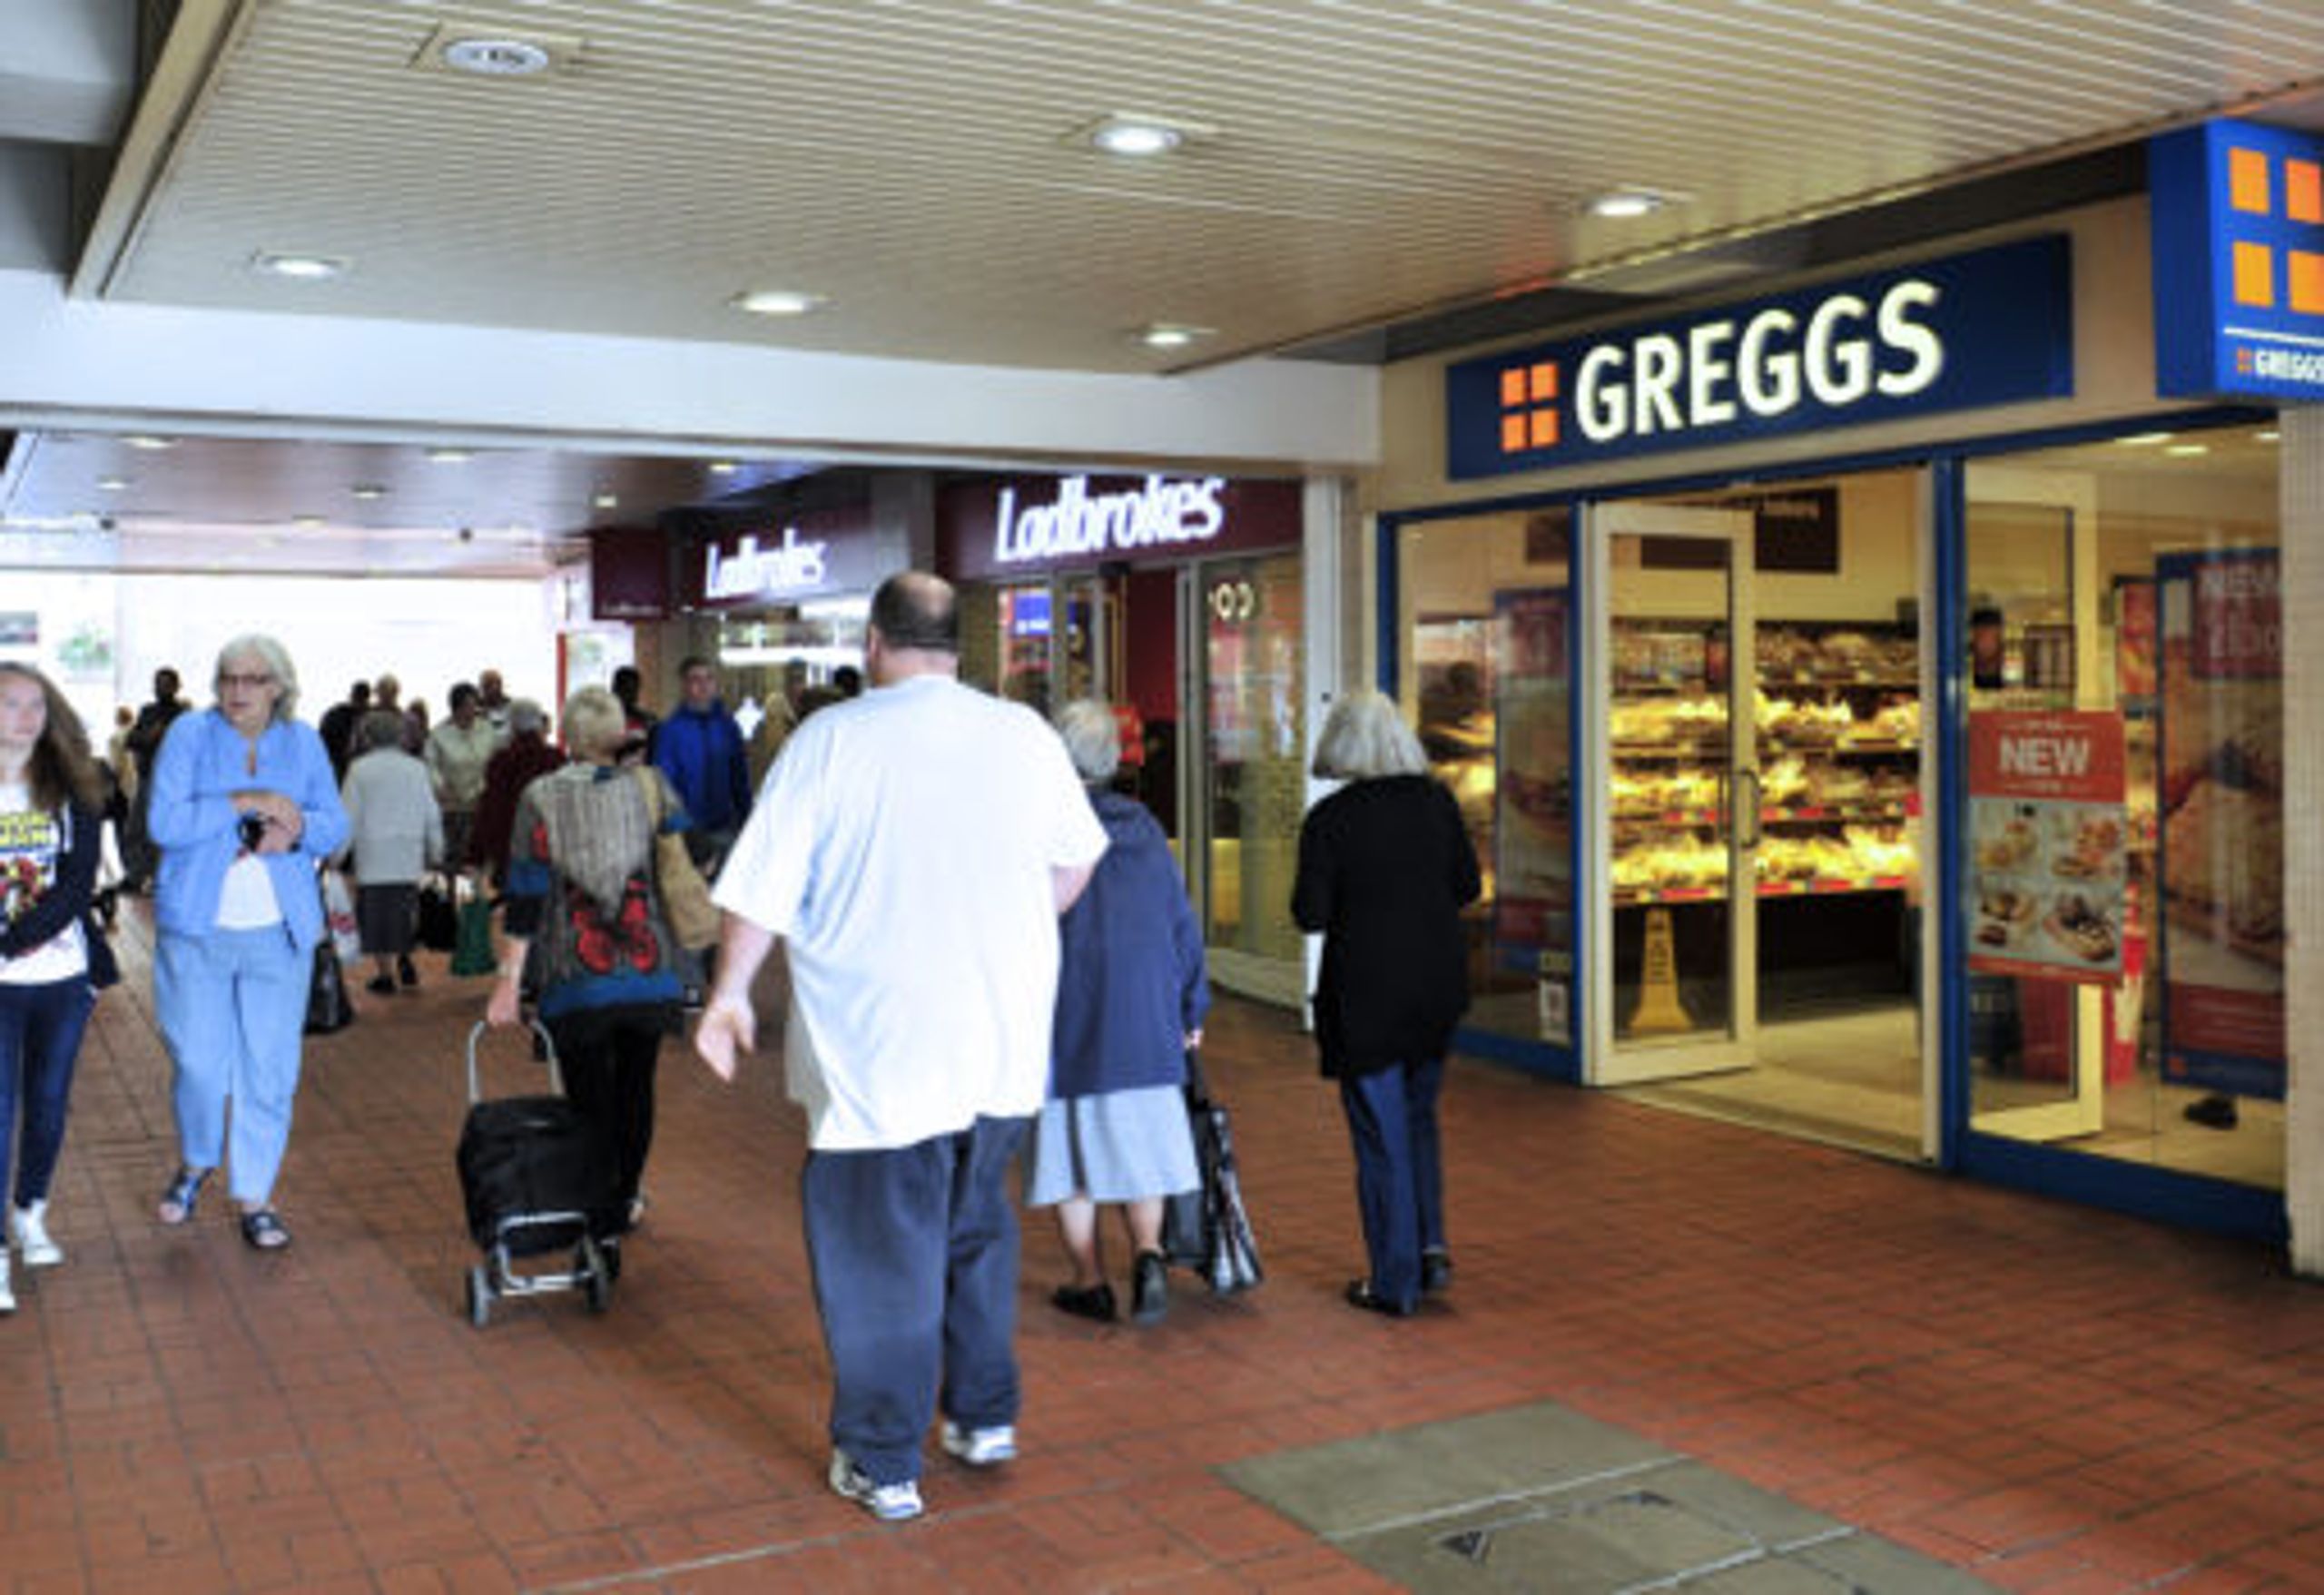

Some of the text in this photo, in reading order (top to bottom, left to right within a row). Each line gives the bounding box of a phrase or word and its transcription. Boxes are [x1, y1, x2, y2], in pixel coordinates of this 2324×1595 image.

[1575, 280, 1943, 442] GREGGS
[995, 473, 1225, 562] Ladbrokes
[2000, 734, 2089, 777] NEW
